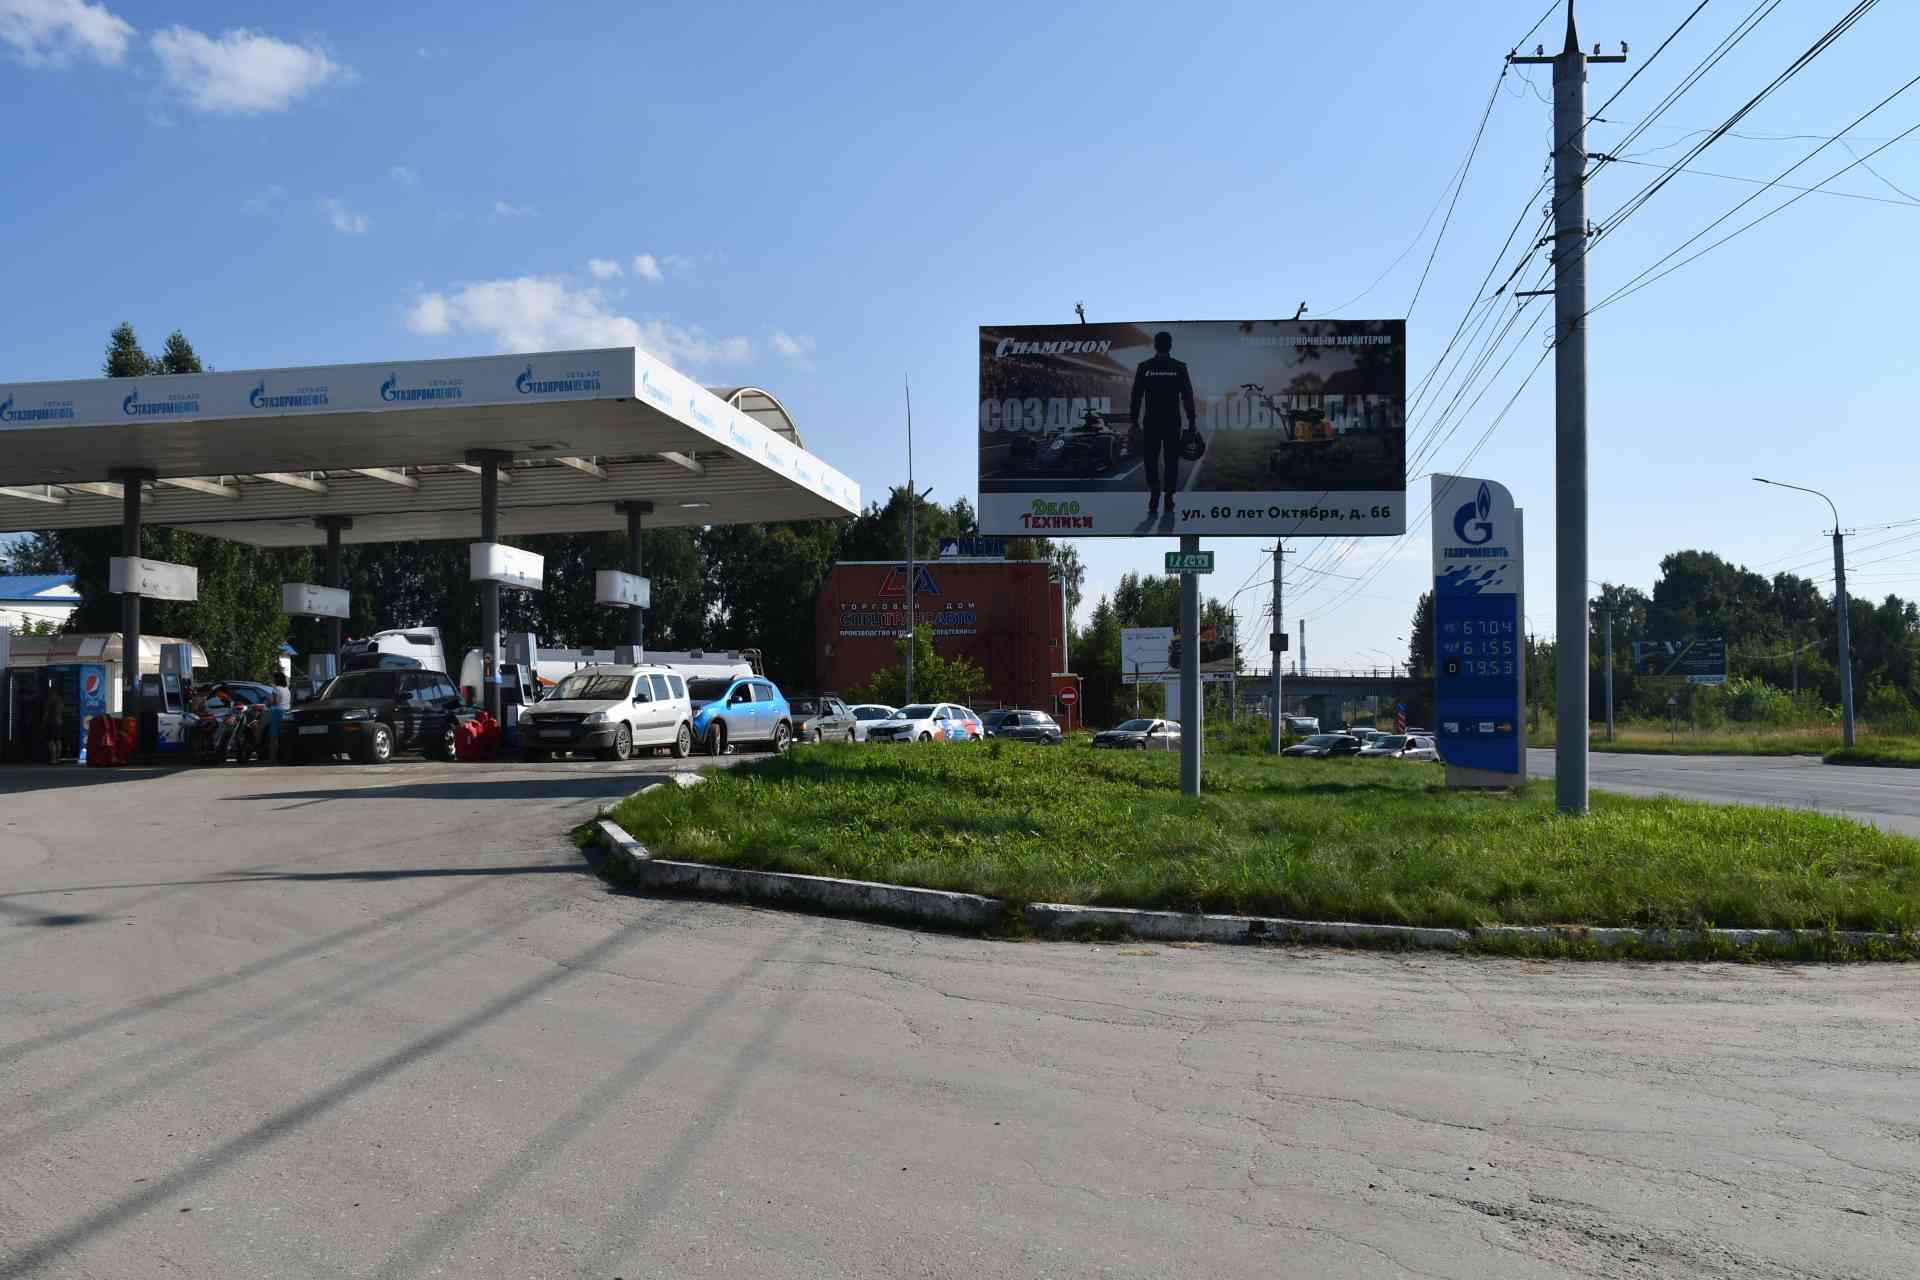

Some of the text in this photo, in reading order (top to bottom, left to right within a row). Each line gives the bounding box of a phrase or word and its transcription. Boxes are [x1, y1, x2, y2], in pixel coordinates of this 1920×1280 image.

[1336, 335, 1391, 345] ХАРАКТЕРОМ
[994, 337, 1112, 359] CHAMPION
[532, 378, 601, 393] ГАЗПРОМНЕФТЬ
[264, 394, 328, 409] ГАЗПРОМНЕФТЬ
[397, 387, 464, 401] ГАЗПРОМНЕФТЬ
[14, 407, 74, 421] ГАЗПРОМНЕФТЬ
[138, 400, 200, 415] ГАЗПРОМНЕФТЬ
[1019, 512, 1094, 529] ТЕХНИКИ
[1181, 505, 1390, 522] ул. 60 лет Октября, д. 66
[1444, 547, 1508, 558] ГАЗПРОМНЕФТЬ
